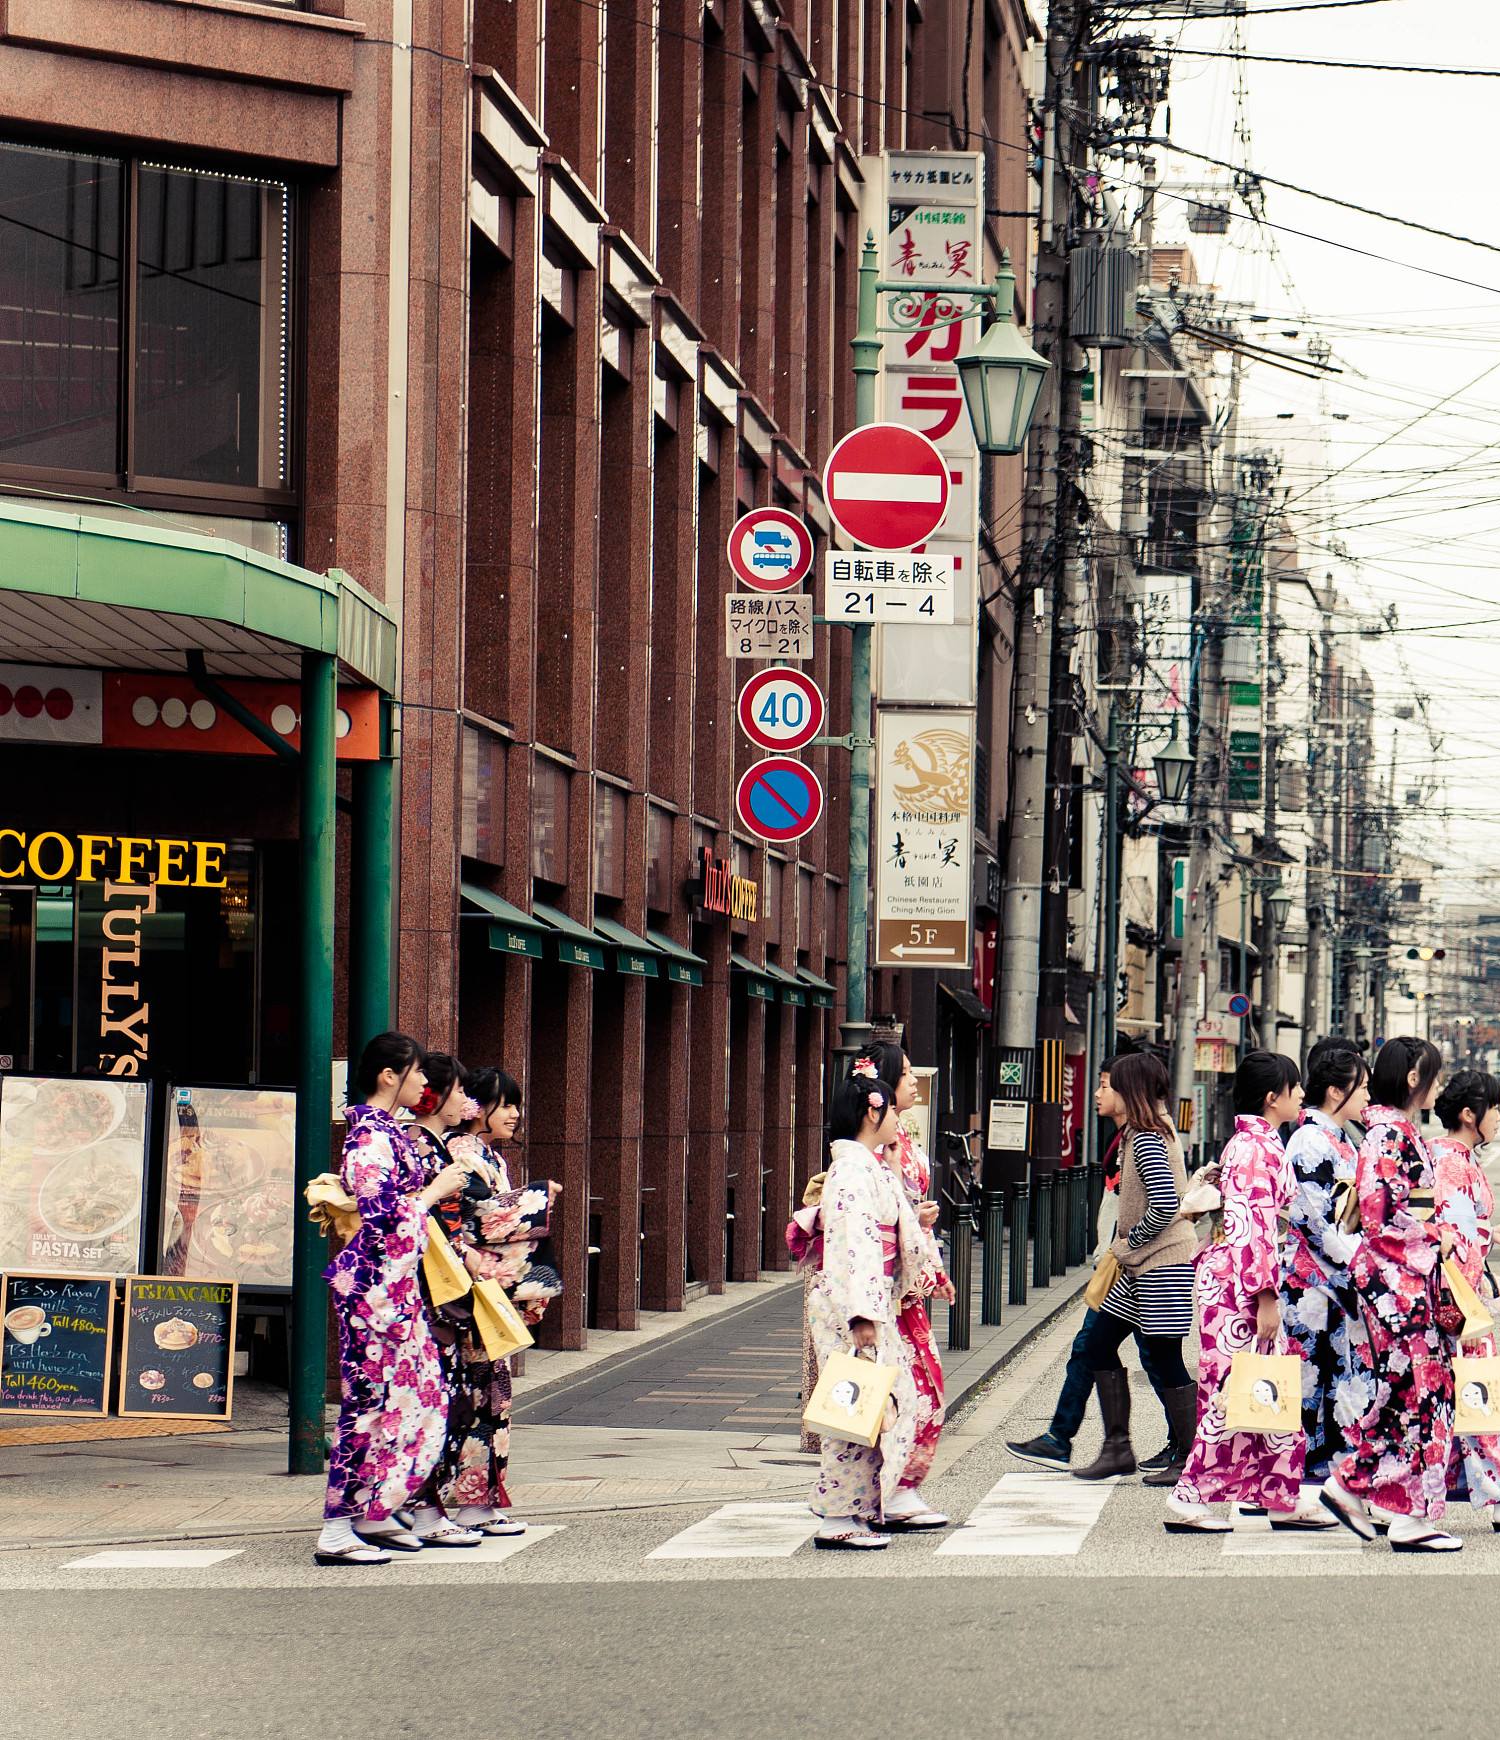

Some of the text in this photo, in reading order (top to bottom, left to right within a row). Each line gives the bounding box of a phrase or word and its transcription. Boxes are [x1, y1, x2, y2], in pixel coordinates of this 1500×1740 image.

[833, 558, 947, 583] 自転車を除く
[731, 619, 809, 634] マイクロを除く
[759, 692, 804, 728] 40
[887, 896, 960, 904] Chinese Restaurant
[937, 906, 956, 914] Gion
[909, 924, 938, 945] 5F
[31, 1240, 103, 1259] PASTA SET
[33, 1282, 58, 1299] Soy
[41, 1299, 69, 1312] milk
[51, 1315, 70, 1329] Tall
[13, 1359, 36, 1370] with
[5, 1374, 80, 1393] Tall 460yen
[17, 1390, 38, 1400] drink
